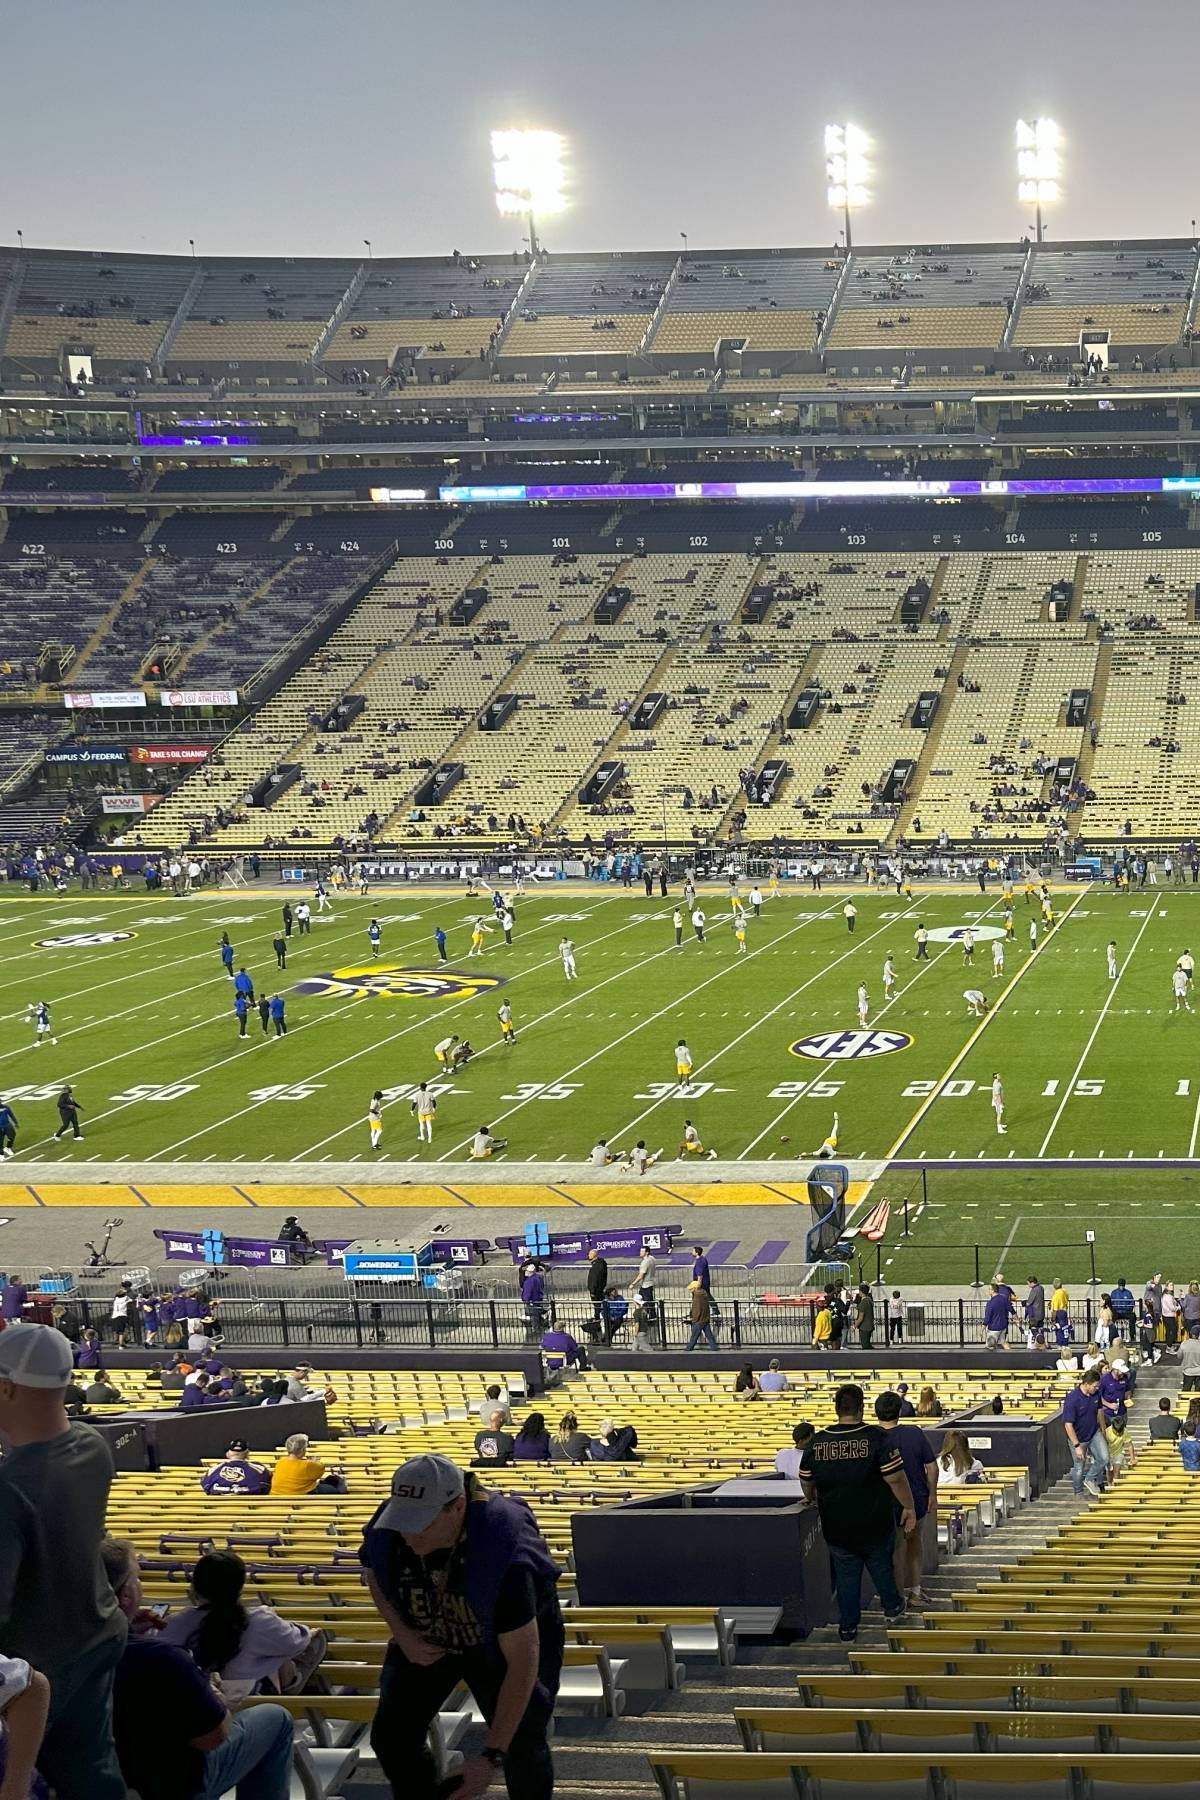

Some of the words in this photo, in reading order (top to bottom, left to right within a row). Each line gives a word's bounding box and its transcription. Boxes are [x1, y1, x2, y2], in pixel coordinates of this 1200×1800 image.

[552, 538, 570, 548] 101
[689, 536, 708, 547] 102
[847, 534, 866, 545] 103
[1005, 534, 1026, 544] 104
[1142, 532, 1162, 542] 105
[22, 544, 46, 554] 422
[216, 544, 238, 553] 423
[340, 541, 360, 552] 424
[434, 539, 454, 550] 100
[46, 754, 78, 762] CAMPUS
[91, 752, 124, 761] FEDERAL
[108, 1084, 202, 1101] 50
[247, 1084, 329, 1101] 45
[499, 1083, 584, 1100] 35
[633, 1082, 716, 1100] 30
[767, 1080, 846, 1098] 25
[901, 1080, 976, 1098] 20
[1040, 1080, 1106, 1096] 15
[114, 1428, 138, 1449] 302-A
[813, 1440, 869, 1461] TIGERS
[392, 1484, 426, 1500] LSU
